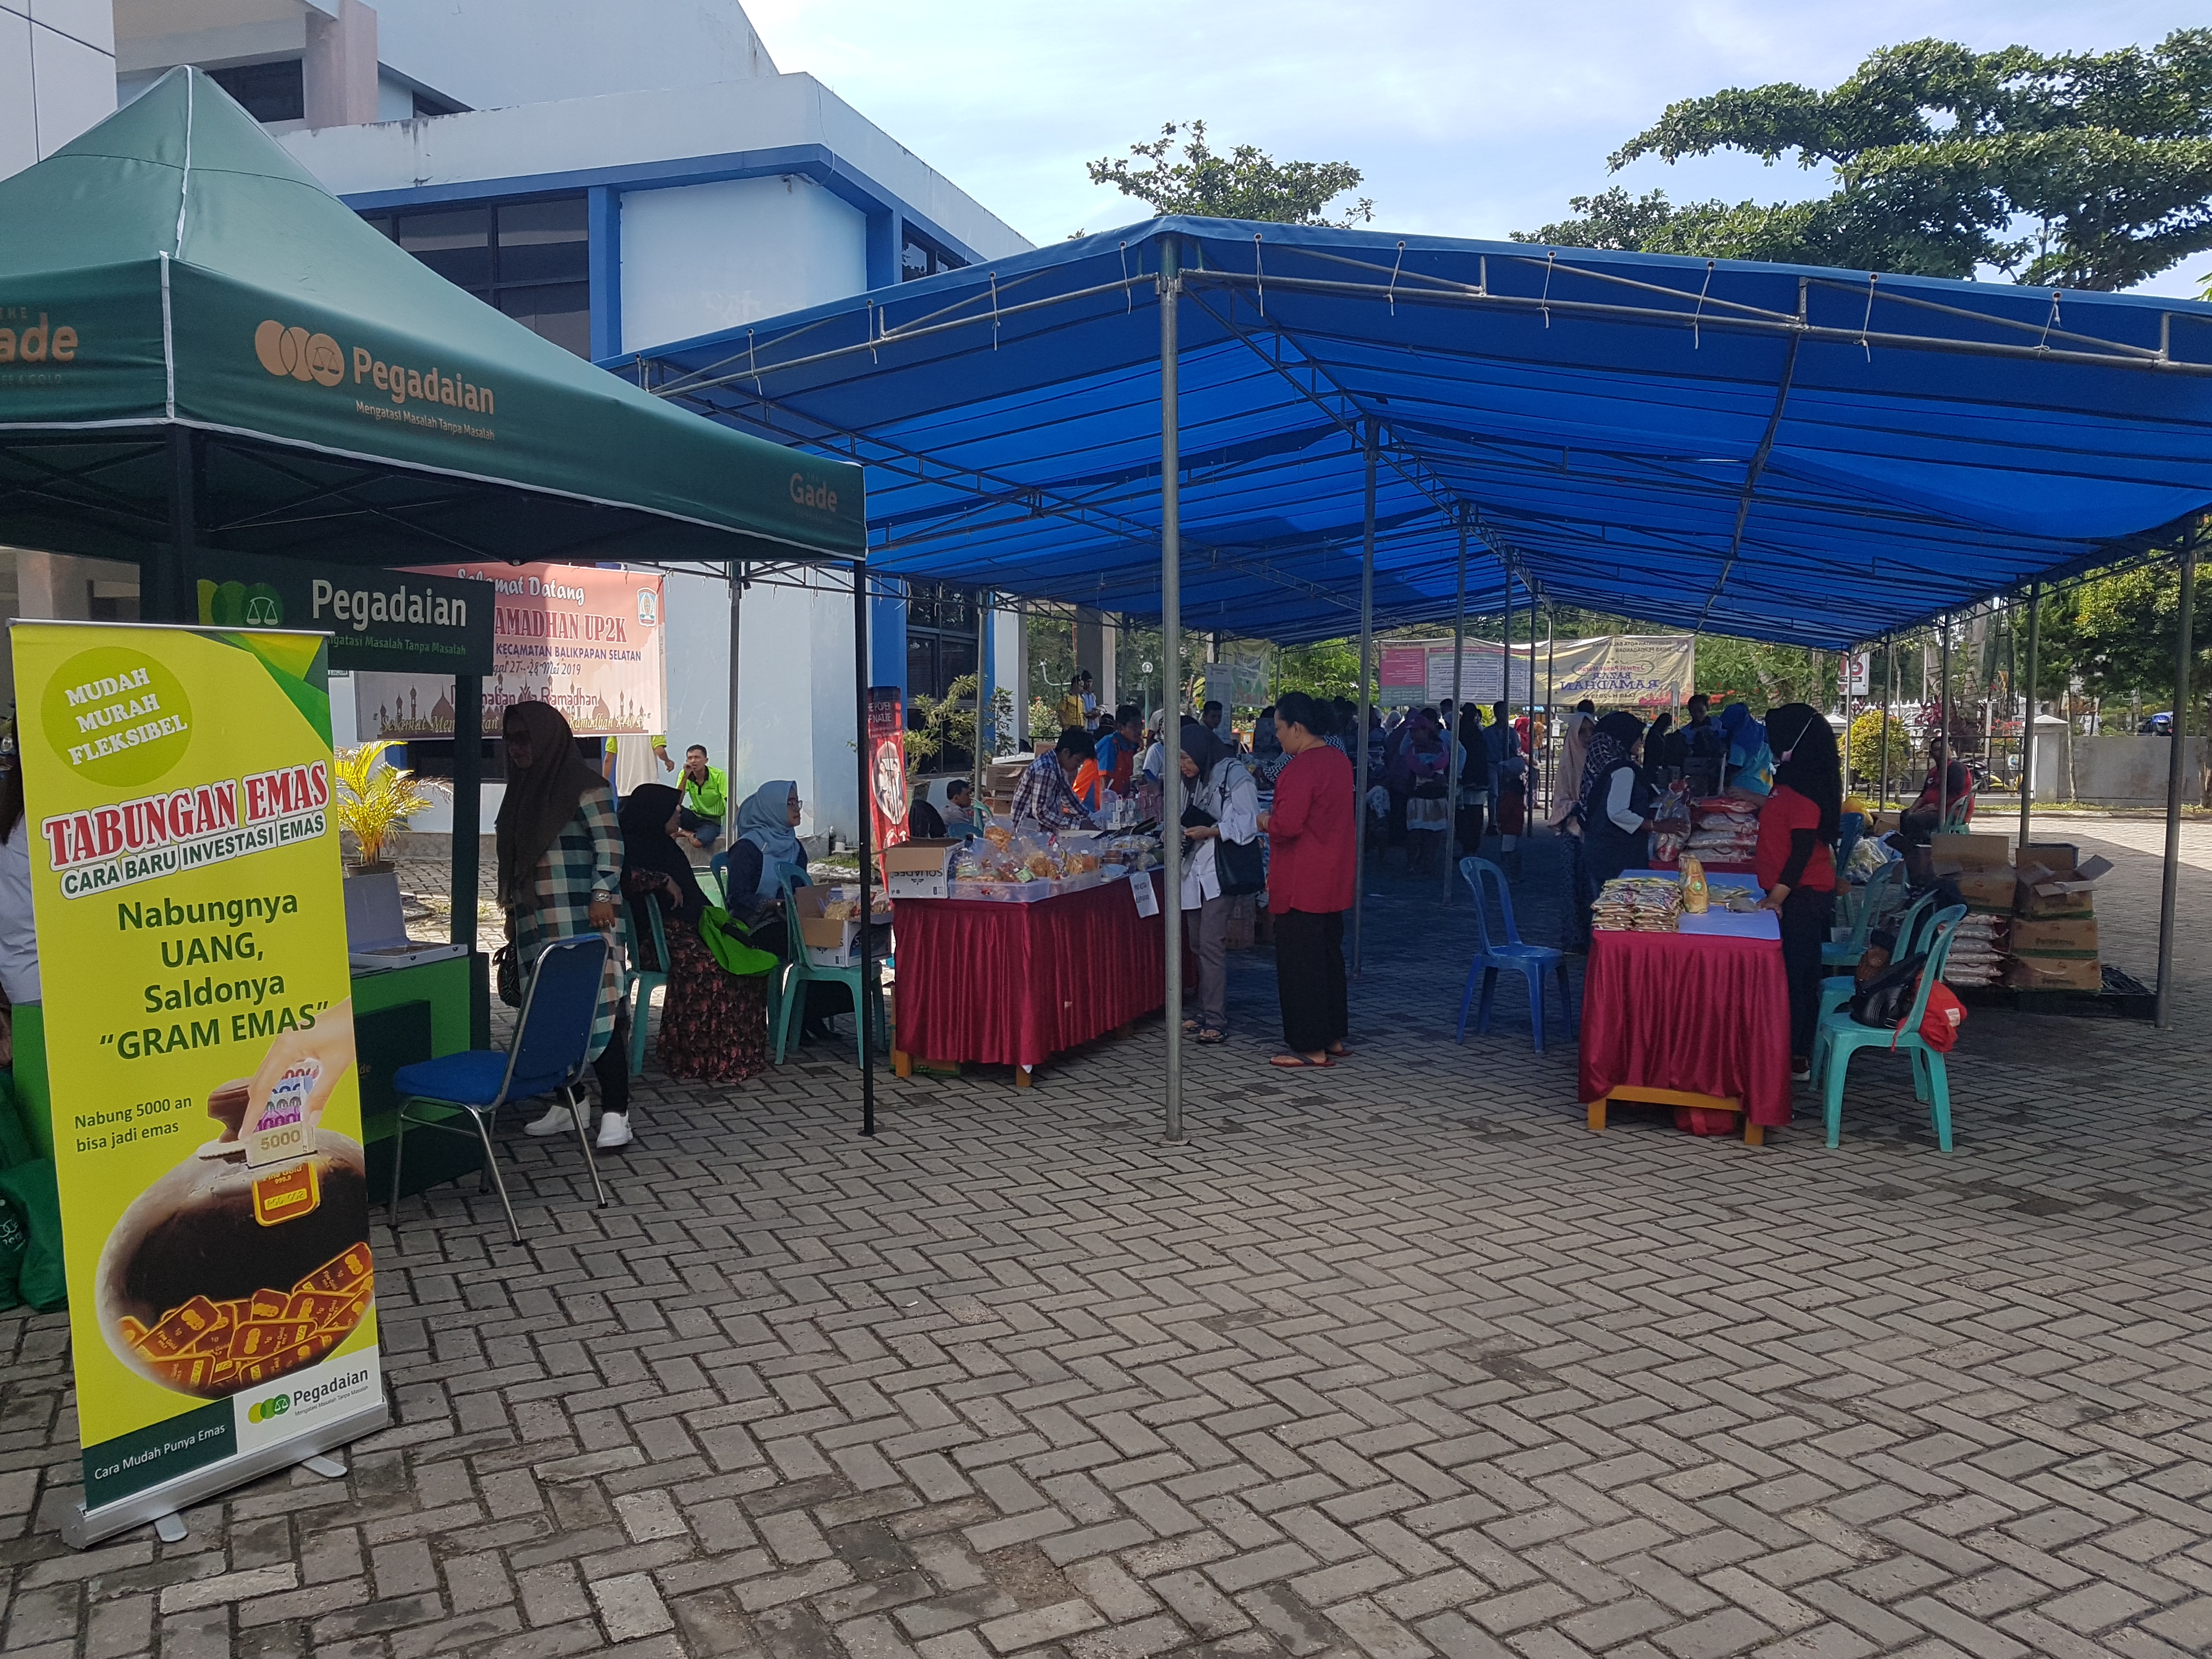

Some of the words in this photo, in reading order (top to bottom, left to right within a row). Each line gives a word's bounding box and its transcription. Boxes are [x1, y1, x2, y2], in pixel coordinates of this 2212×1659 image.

[0, 312, 78, 363] ade
[353, 346, 494, 415] Pegadaian
[356, 400, 402, 421] Mengatasi
[403, 410, 438, 429] Masalah
[438, 417, 462, 435] Tanpa
[463, 424, 494, 441] Masalah
[790, 473, 837, 512] Gade
[312, 579, 466, 631] Pegadaian
[528, 576, 585, 607] Datang
[494, 607, 579, 641] AMADHAN
[584, 615, 627, 644] UP2K
[365, 636, 403, 650] Masalah
[405, 639, 430, 652] Tanpa
[431, 642, 466, 655] Masalah
[496, 643, 551, 658] KECAMATAN
[555, 646, 607, 661] BALIKPAPAN
[609, 650, 641, 662] SELATAN
[65, 667, 151, 707] MUDAH
[540, 661, 560, 675] Mei
[561, 663, 581, 675] 2019
[75, 693, 161, 733] MURAH
[541, 686, 599, 707] Ramadhan
[67, 714, 189, 766] FLEKSIBEL
[568, 713, 613, 731] Ramadhan
[45, 783, 235, 867] TABUNGAN
[245, 764, 328, 821] EMAS
[64, 865, 121, 894] CARA
[125, 850, 177, 881] BARU
[183, 827, 273, 866] INVESTASI
[279, 815, 324, 842] EMAS
[117, 894, 299, 932] Nabungnya
[161, 932, 264, 969] UANG,
[144, 974, 286, 1014] Saldonya
[74, 1108, 132, 1130] Nabung
[136, 1098, 171, 1118] 5000
[174, 1097, 193, 1110] an
[76, 1137, 108, 1153] bisa
[111, 1127, 138, 1149] jadi
[141, 1122, 179, 1138] emas
[261, 1129, 301, 1151] 5000
[293, 1370, 369, 1406] Pegadaian
[94, 1464, 120, 1480] Cara
[122, 1447, 161, 1470] Mudah
[164, 1435, 195, 1454] Punya
[198, 1425, 225, 1442] Emas
